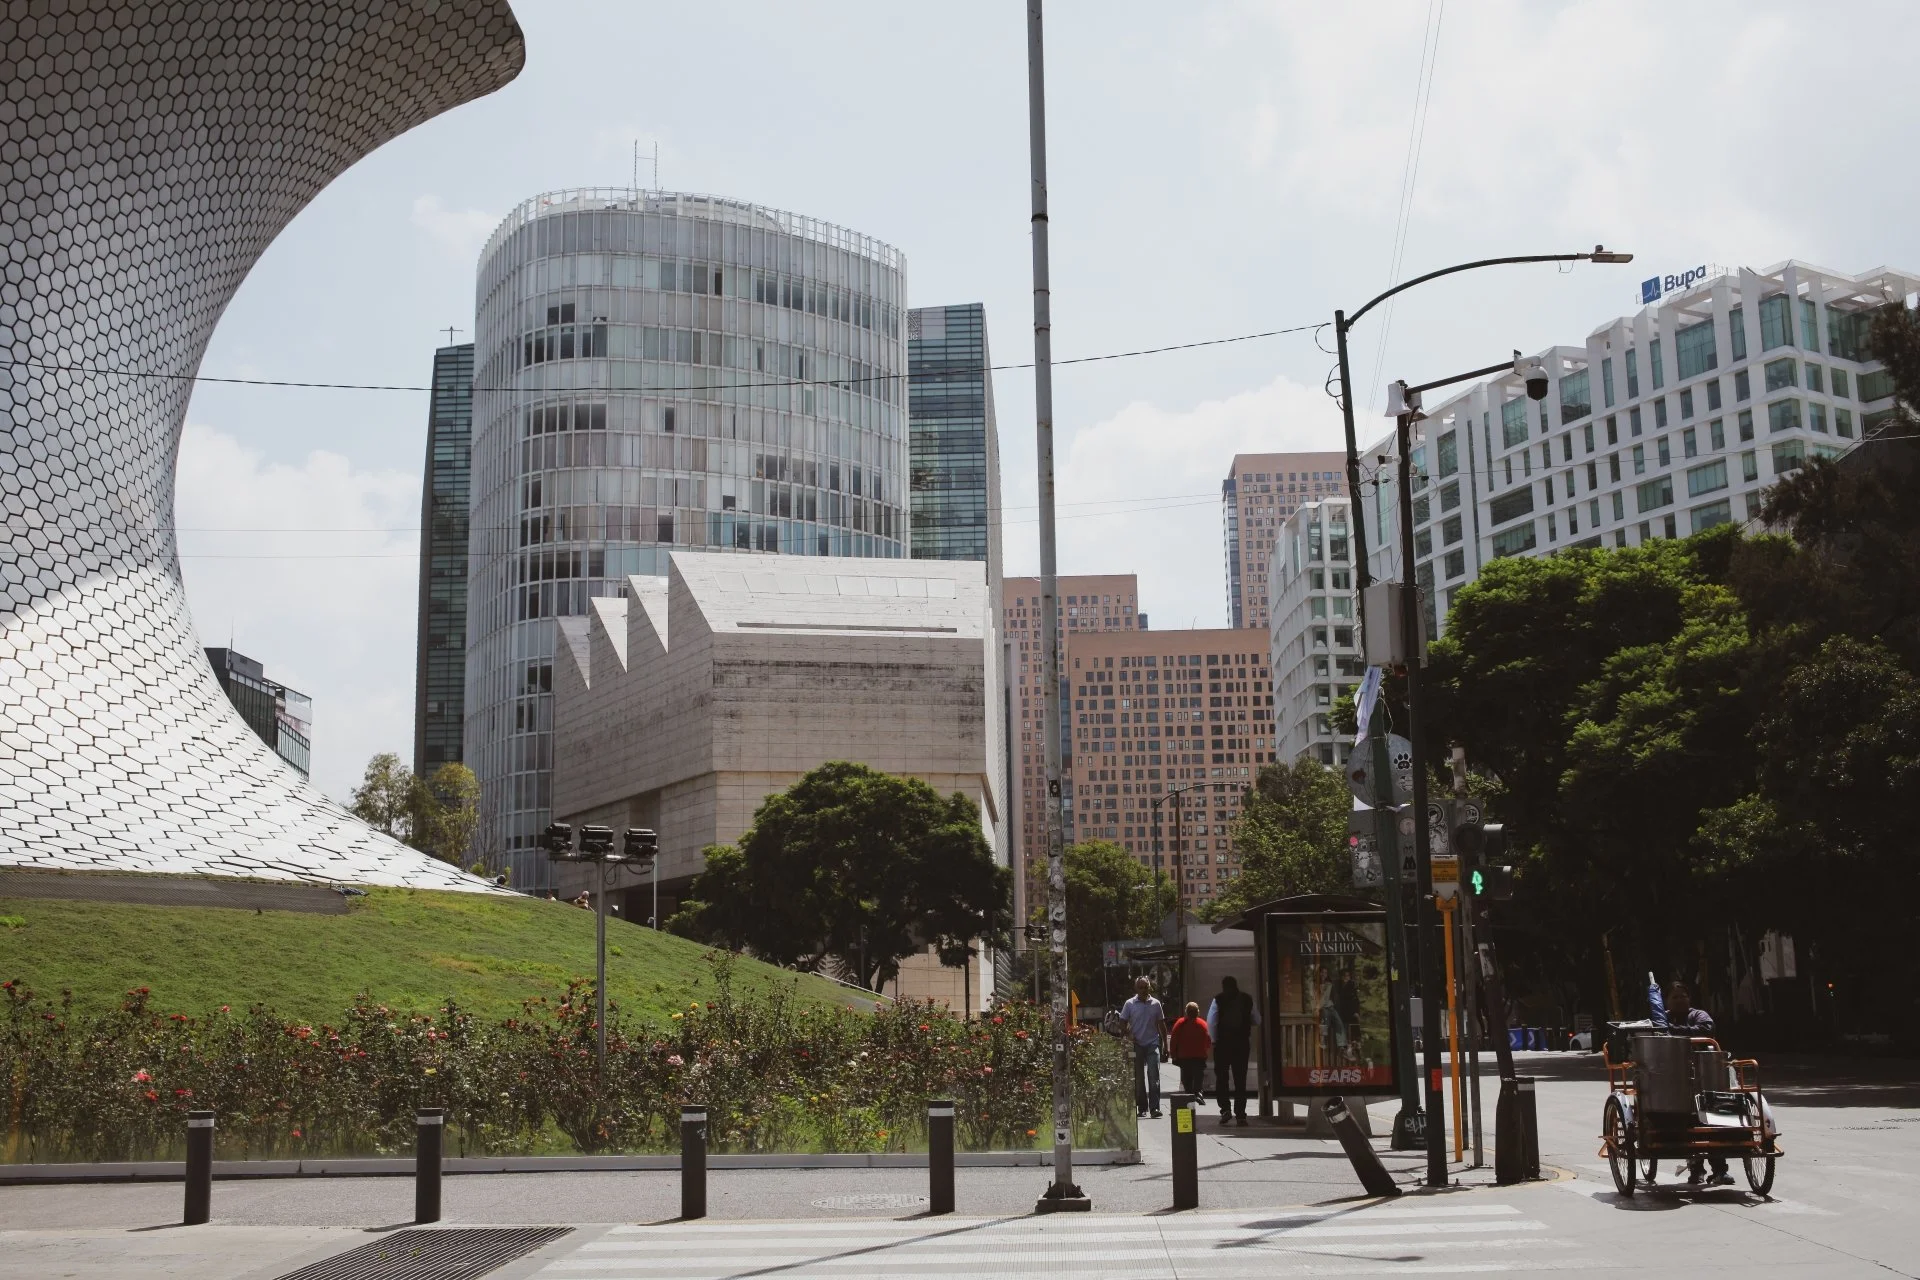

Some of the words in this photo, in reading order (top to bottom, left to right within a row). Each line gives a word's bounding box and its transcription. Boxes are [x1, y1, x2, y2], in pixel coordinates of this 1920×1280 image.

[1664, 265, 1706, 292] Bupa
[1308, 931, 1354, 942] FALLING
[1300, 943, 1312, 953] IN
[1316, 943, 1363, 953] FASHION
[1309, 1069, 1361, 1083] SEARS
